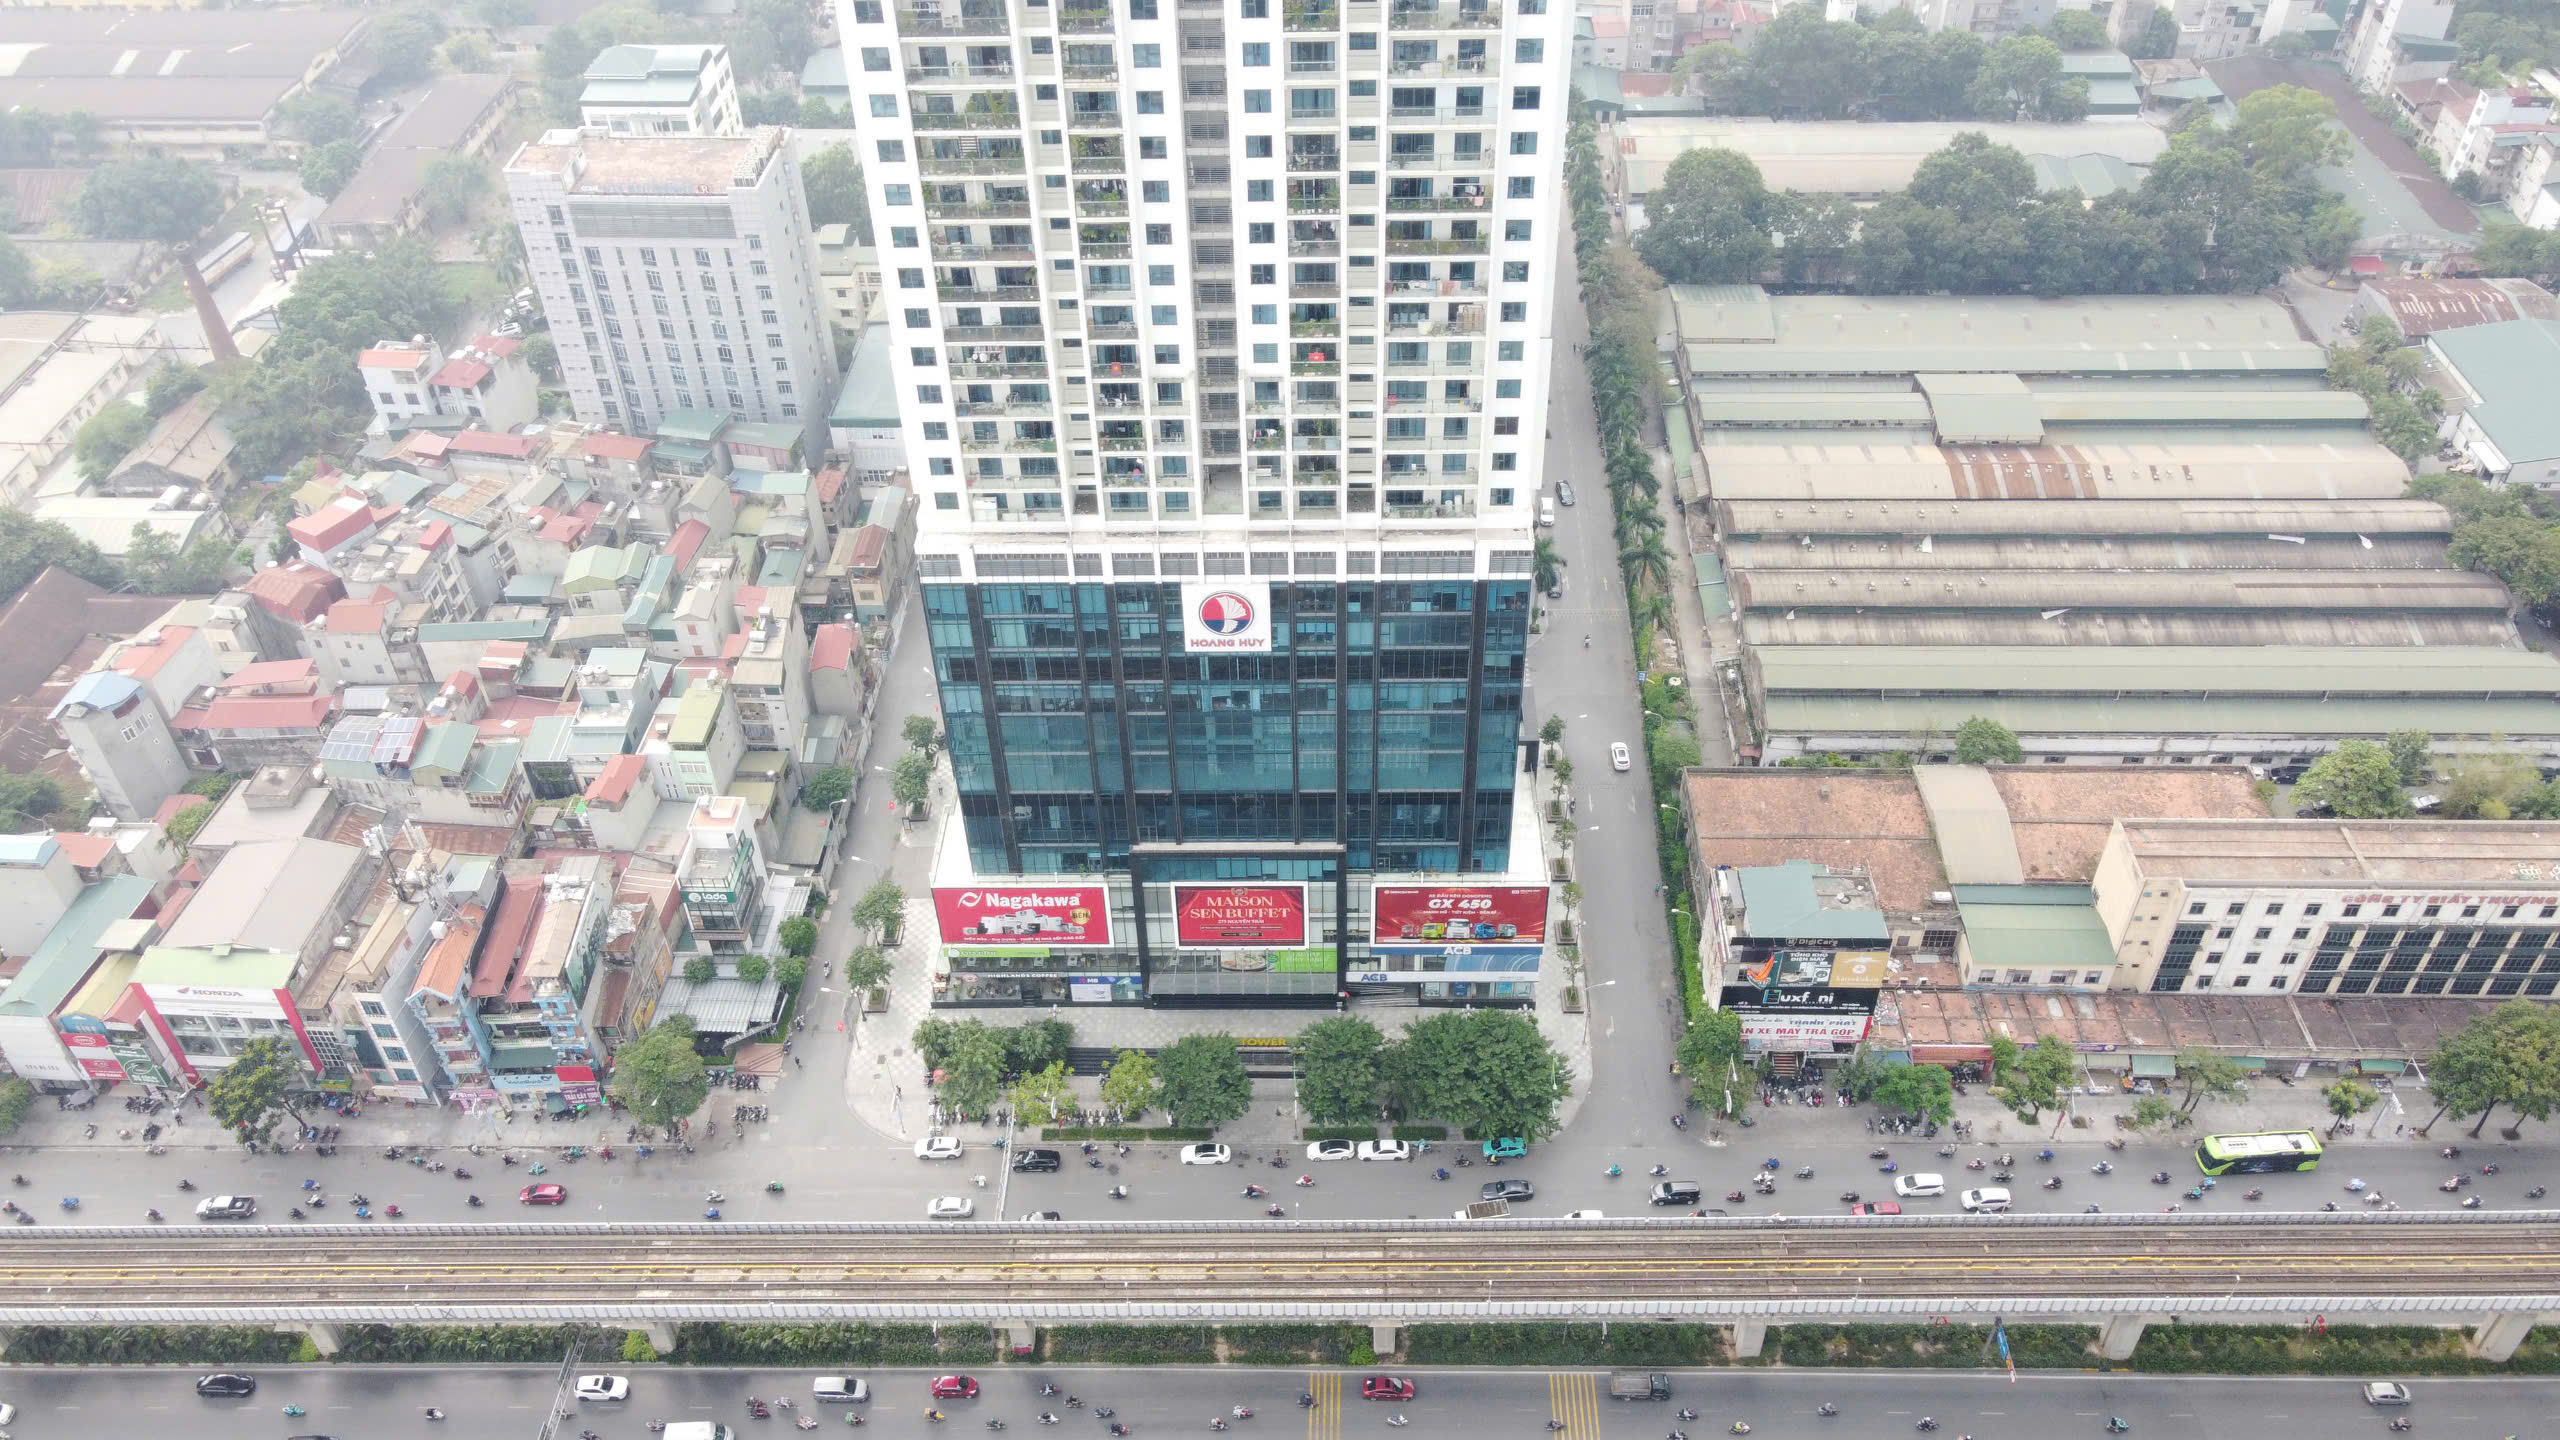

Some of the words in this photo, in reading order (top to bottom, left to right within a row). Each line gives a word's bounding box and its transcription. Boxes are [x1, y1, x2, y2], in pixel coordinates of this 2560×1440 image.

[1190, 639, 1235, 647] HOANG
[1239, 639, 1265, 647] HUY
[986, 893, 1081, 909] Nagakawa
[1207, 896, 1273, 907] MAISON
[1428, 899, 1456, 909] GX
[1457, 899, 1493, 909] 450
[2400, 896, 2424, 904] TY
[1190, 908, 1223, 918] SEN
[1226, 908, 1291, 918] BUFFET
[1444, 946, 1472, 955] ACB
[1361, 973, 1388, 982] ACB
[192, 989, 243, 997] HONDA
[1240, 1037, 1289, 1046] TOWER
